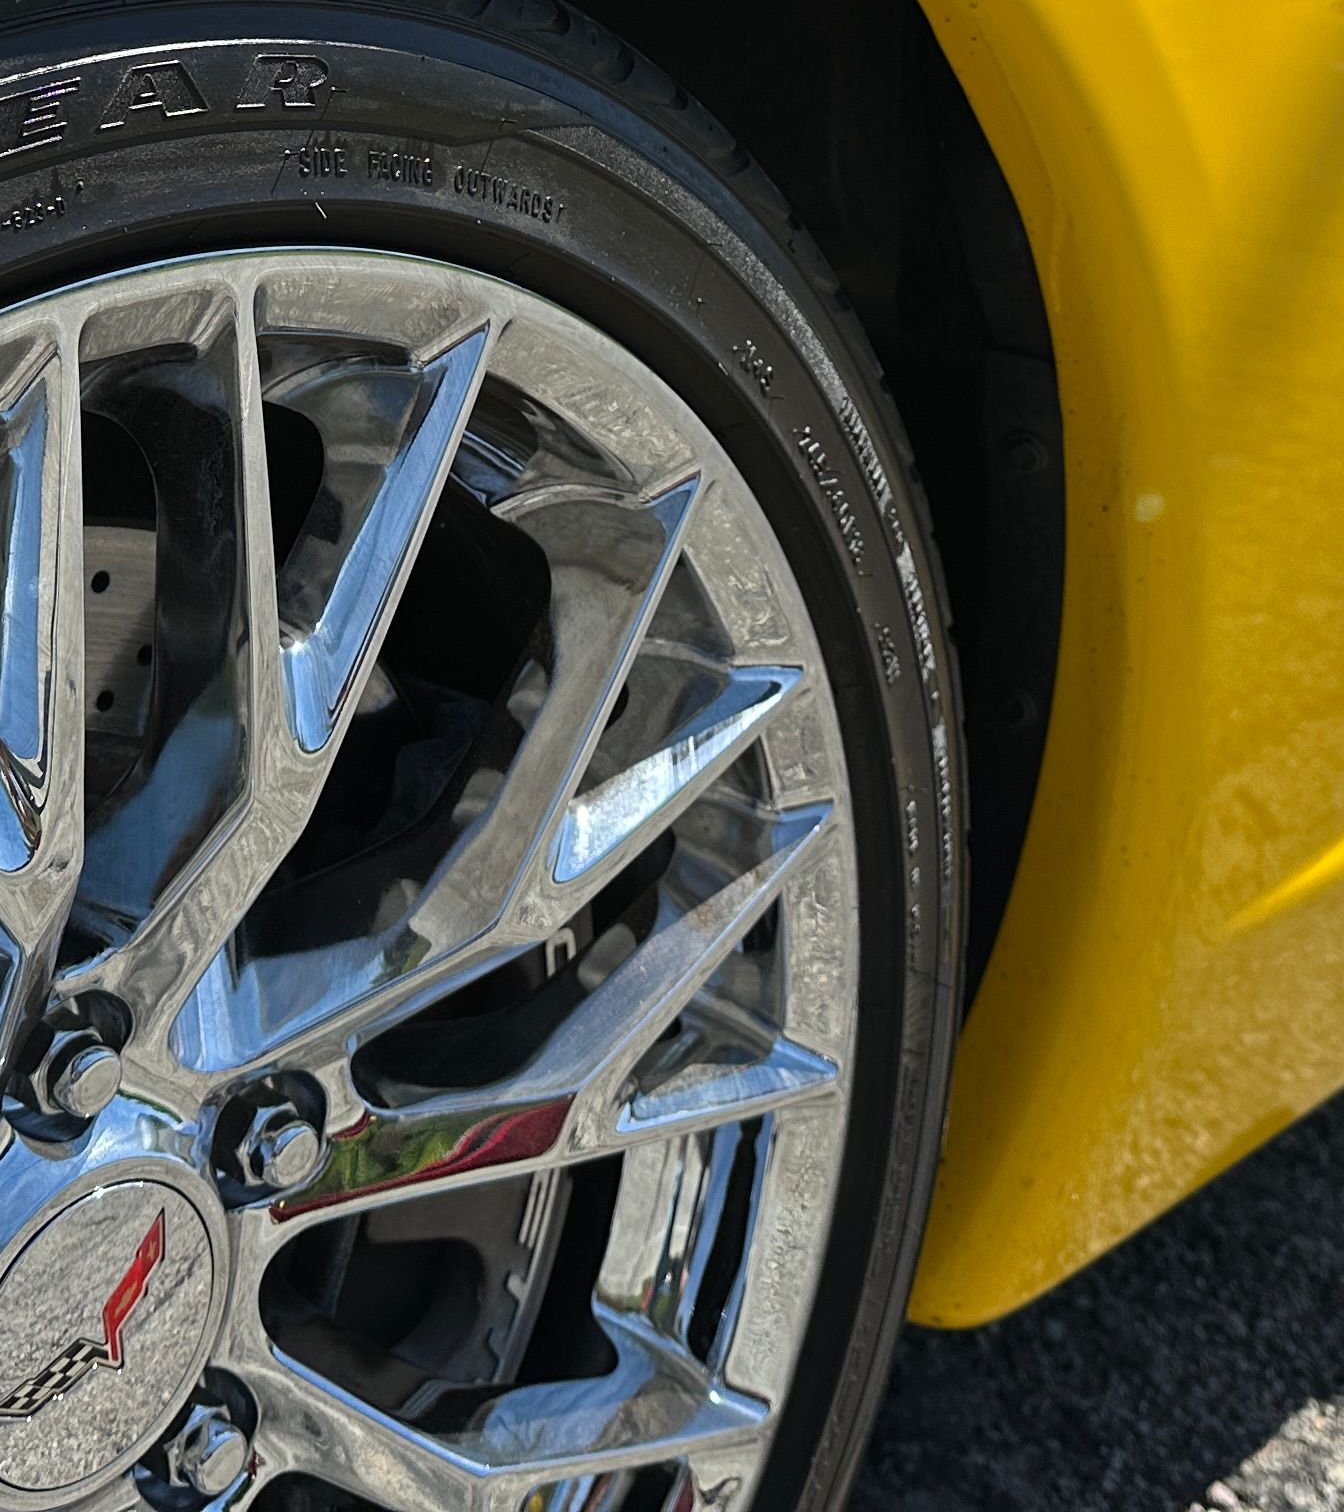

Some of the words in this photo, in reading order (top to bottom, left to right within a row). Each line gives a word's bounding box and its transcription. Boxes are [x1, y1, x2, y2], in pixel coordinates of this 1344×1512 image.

[298, 147, 348, 178] SIDE
[367, 149, 433, 187] FACING
[453, 164, 552, 223] OUTWARDS
